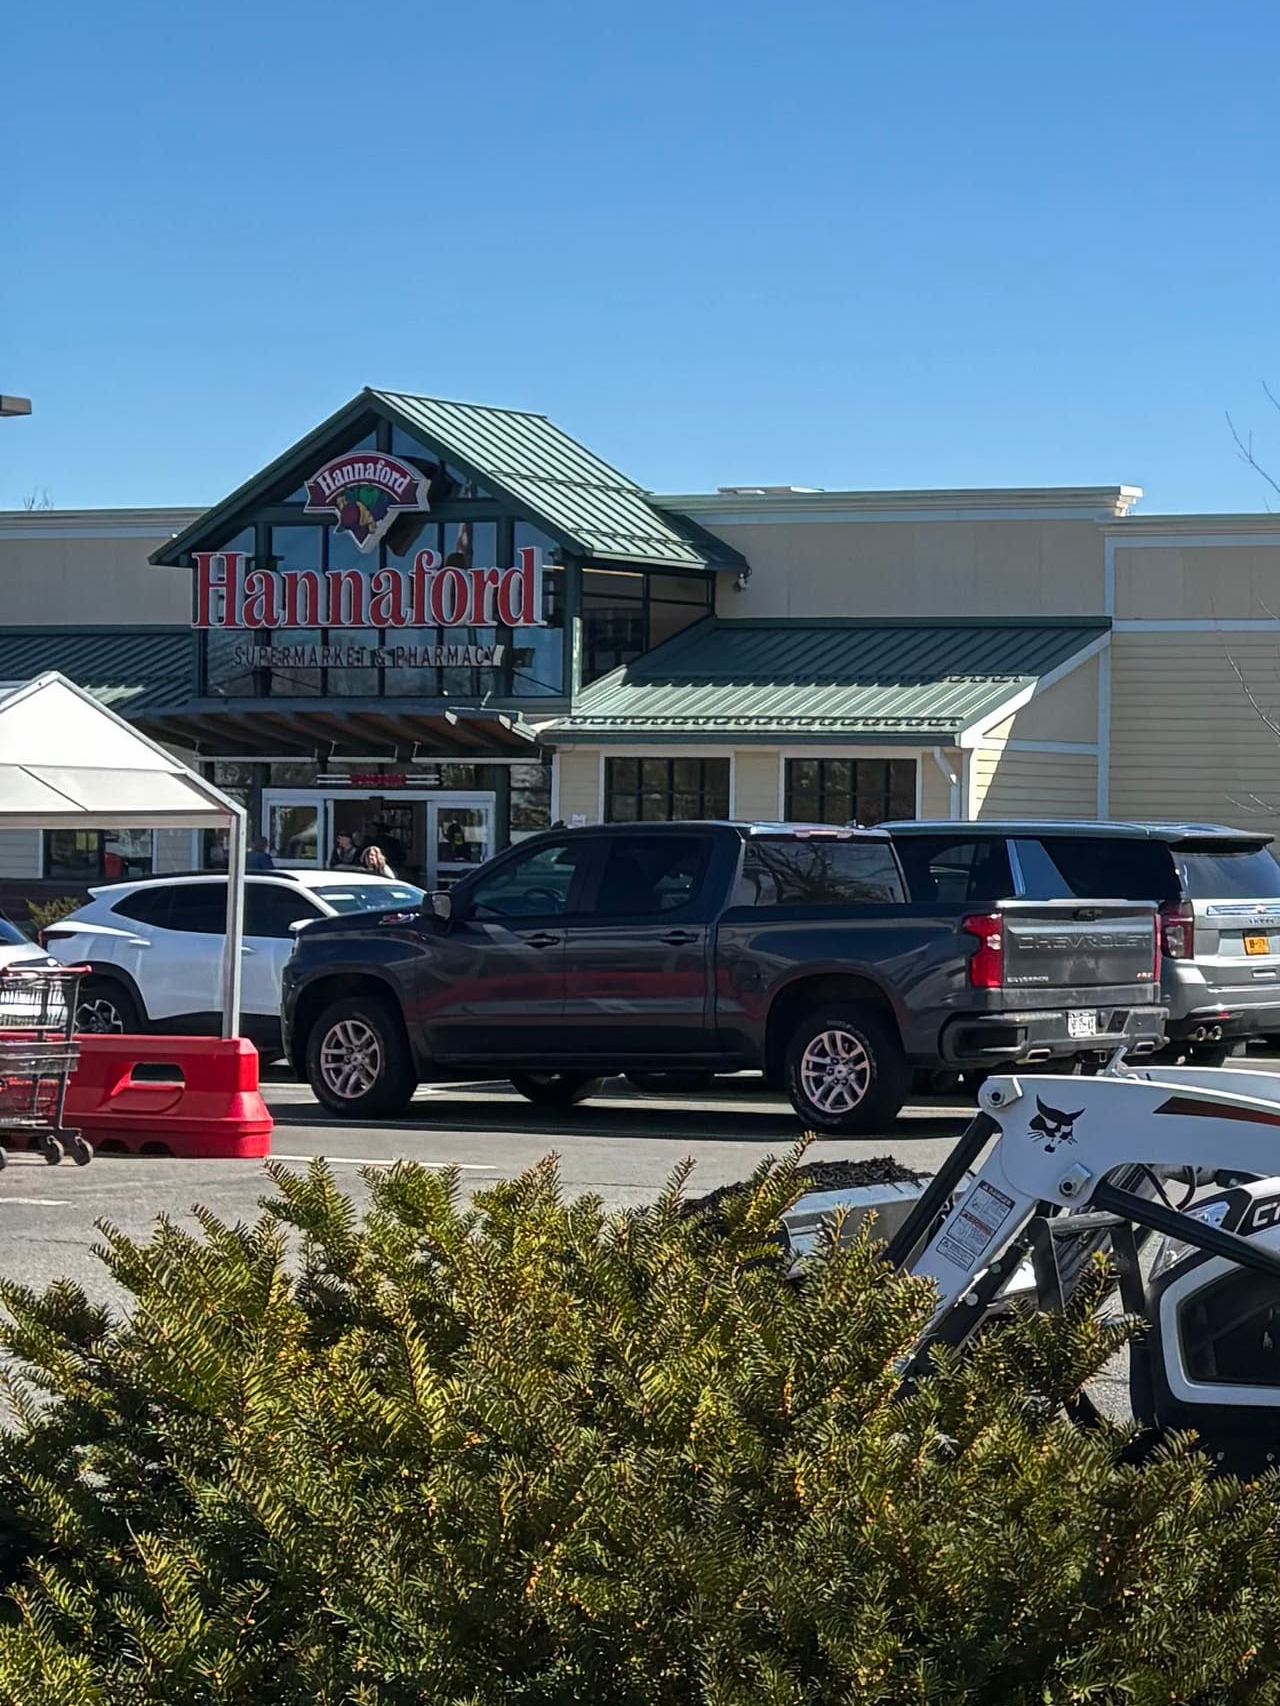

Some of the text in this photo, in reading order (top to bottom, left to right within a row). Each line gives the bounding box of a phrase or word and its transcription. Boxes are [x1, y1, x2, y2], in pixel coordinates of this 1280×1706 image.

[316, 458, 411, 496] Hannaford
[191, 546, 548, 629] Hannaford
[234, 644, 496, 667] SUPERMARKET & PHARMACY
[1018, 933, 1151, 950] CHEVROLET
